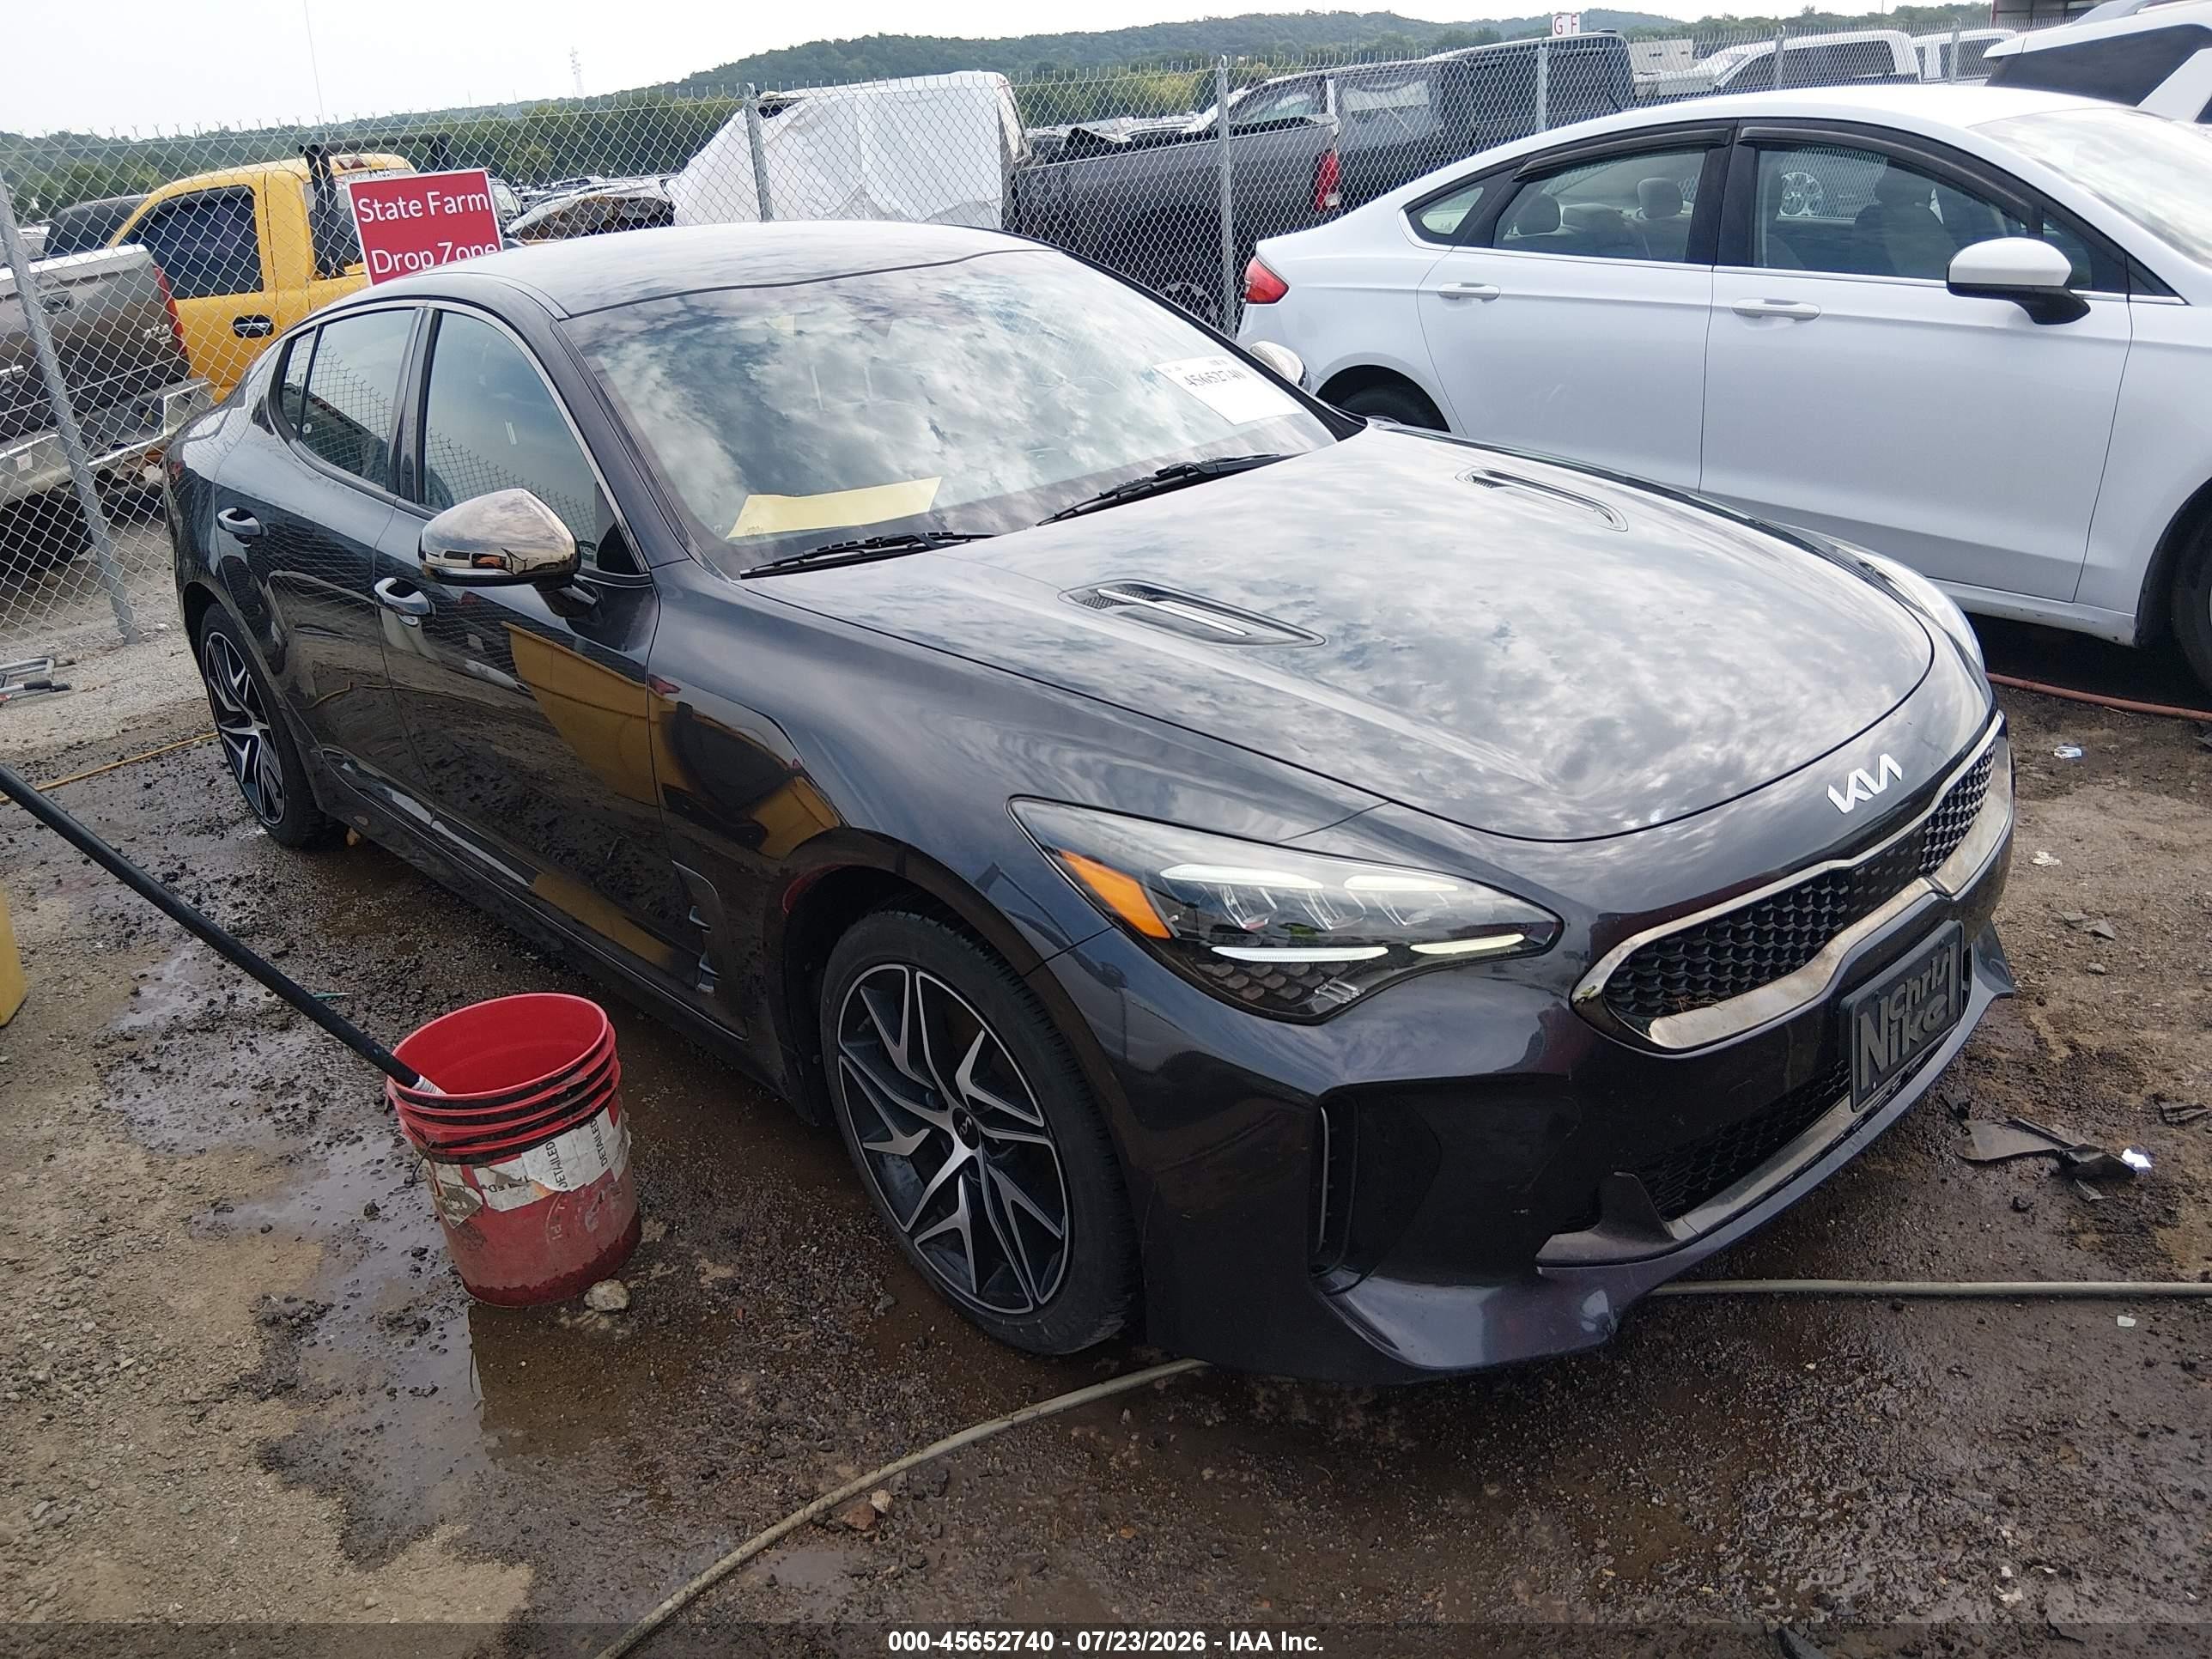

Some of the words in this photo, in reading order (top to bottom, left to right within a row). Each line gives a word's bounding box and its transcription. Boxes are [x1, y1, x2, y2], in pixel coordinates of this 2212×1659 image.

[1553, 15, 1564, 35] G
[1570, 15, 1577, 34] F
[357, 196, 423, 223] State
[426, 191, 489, 216] Farm
[370, 247, 434, 275] Drop
[590, 1118, 609, 1167] DETAILED
